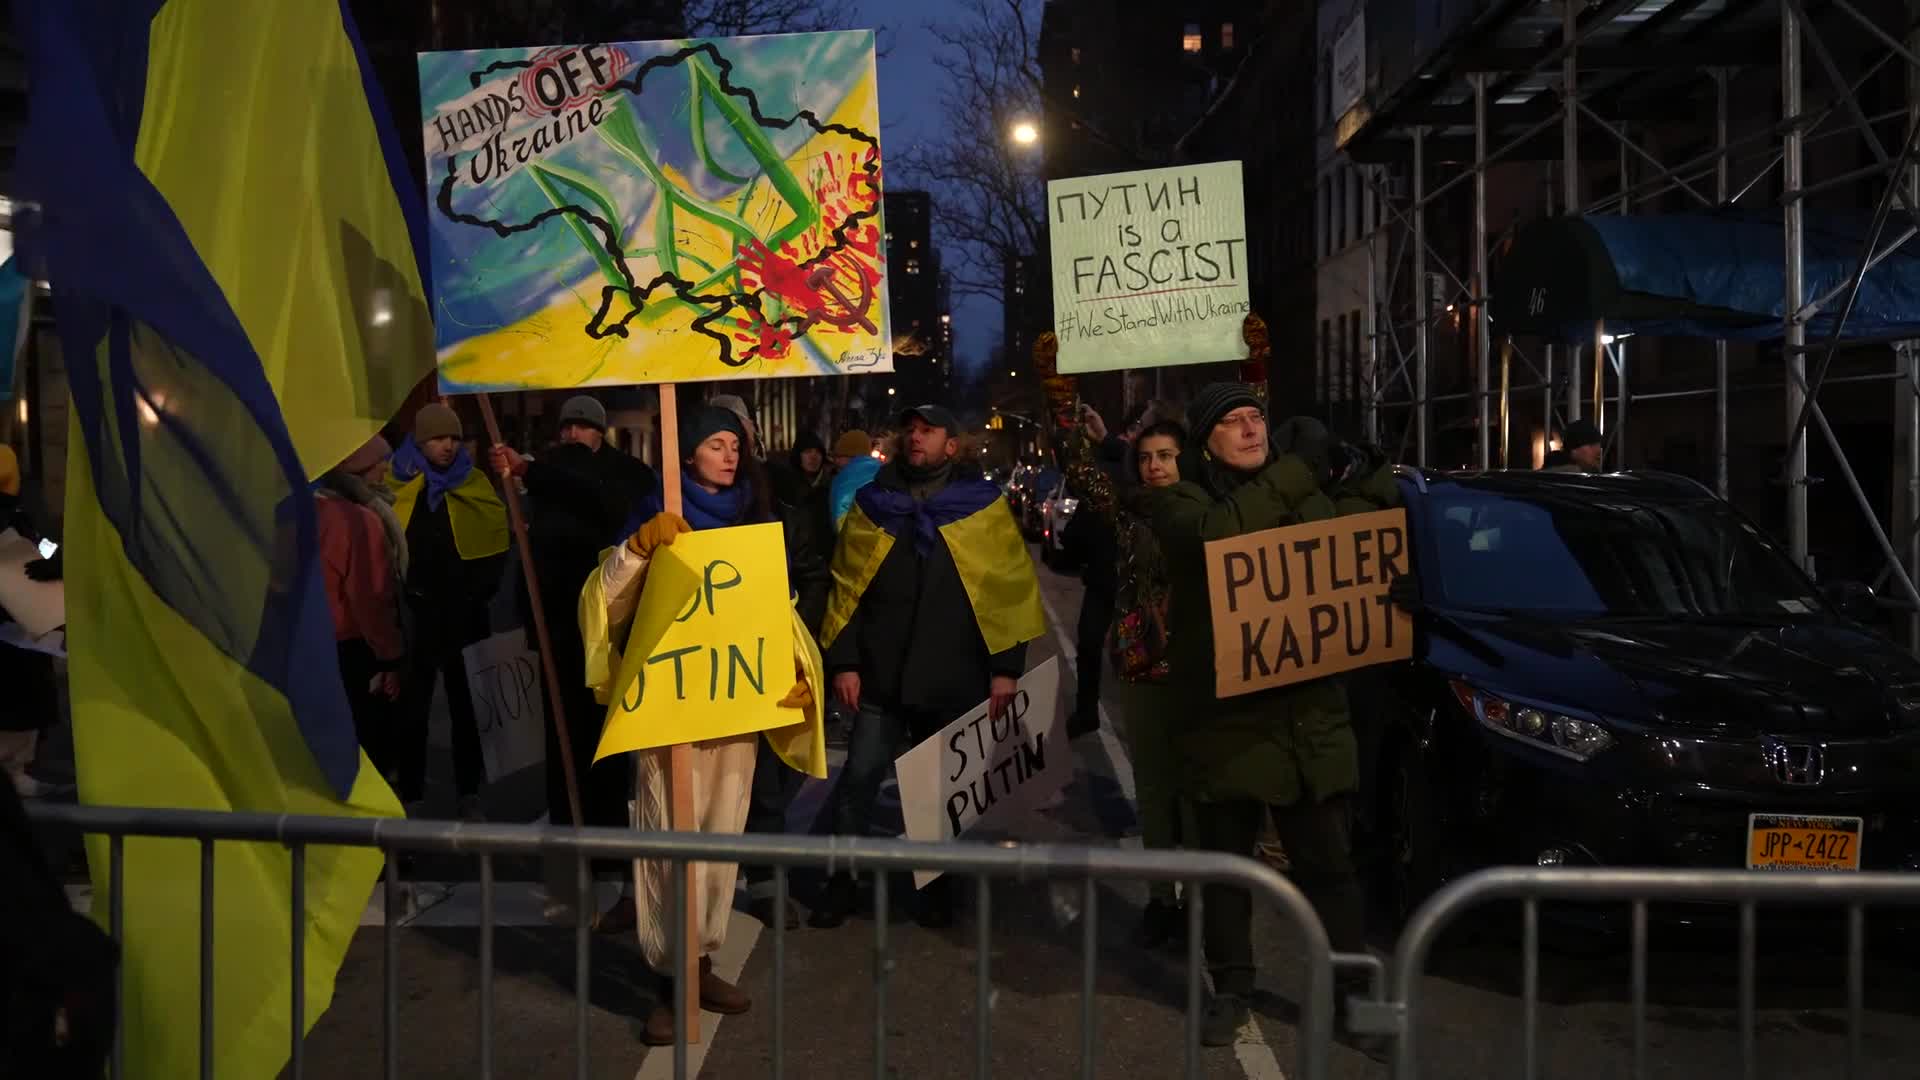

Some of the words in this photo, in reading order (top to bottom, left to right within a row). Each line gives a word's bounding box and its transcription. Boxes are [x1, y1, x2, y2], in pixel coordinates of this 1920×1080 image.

[433, 81, 526, 152] HANDS
[535, 43, 610, 107] OFF
[471, 99, 609, 184] Ukraine
[1057, 176, 1201, 223] ПУТИН
[1119, 225, 1142, 248] is
[1161, 219, 1183, 243] a
[1073, 239, 1245, 294] FASCIST
[1223, 527, 1403, 612] PUTLER
[1241, 595, 1395, 681] KAPUT
[949, 689, 1030, 782] STOP
